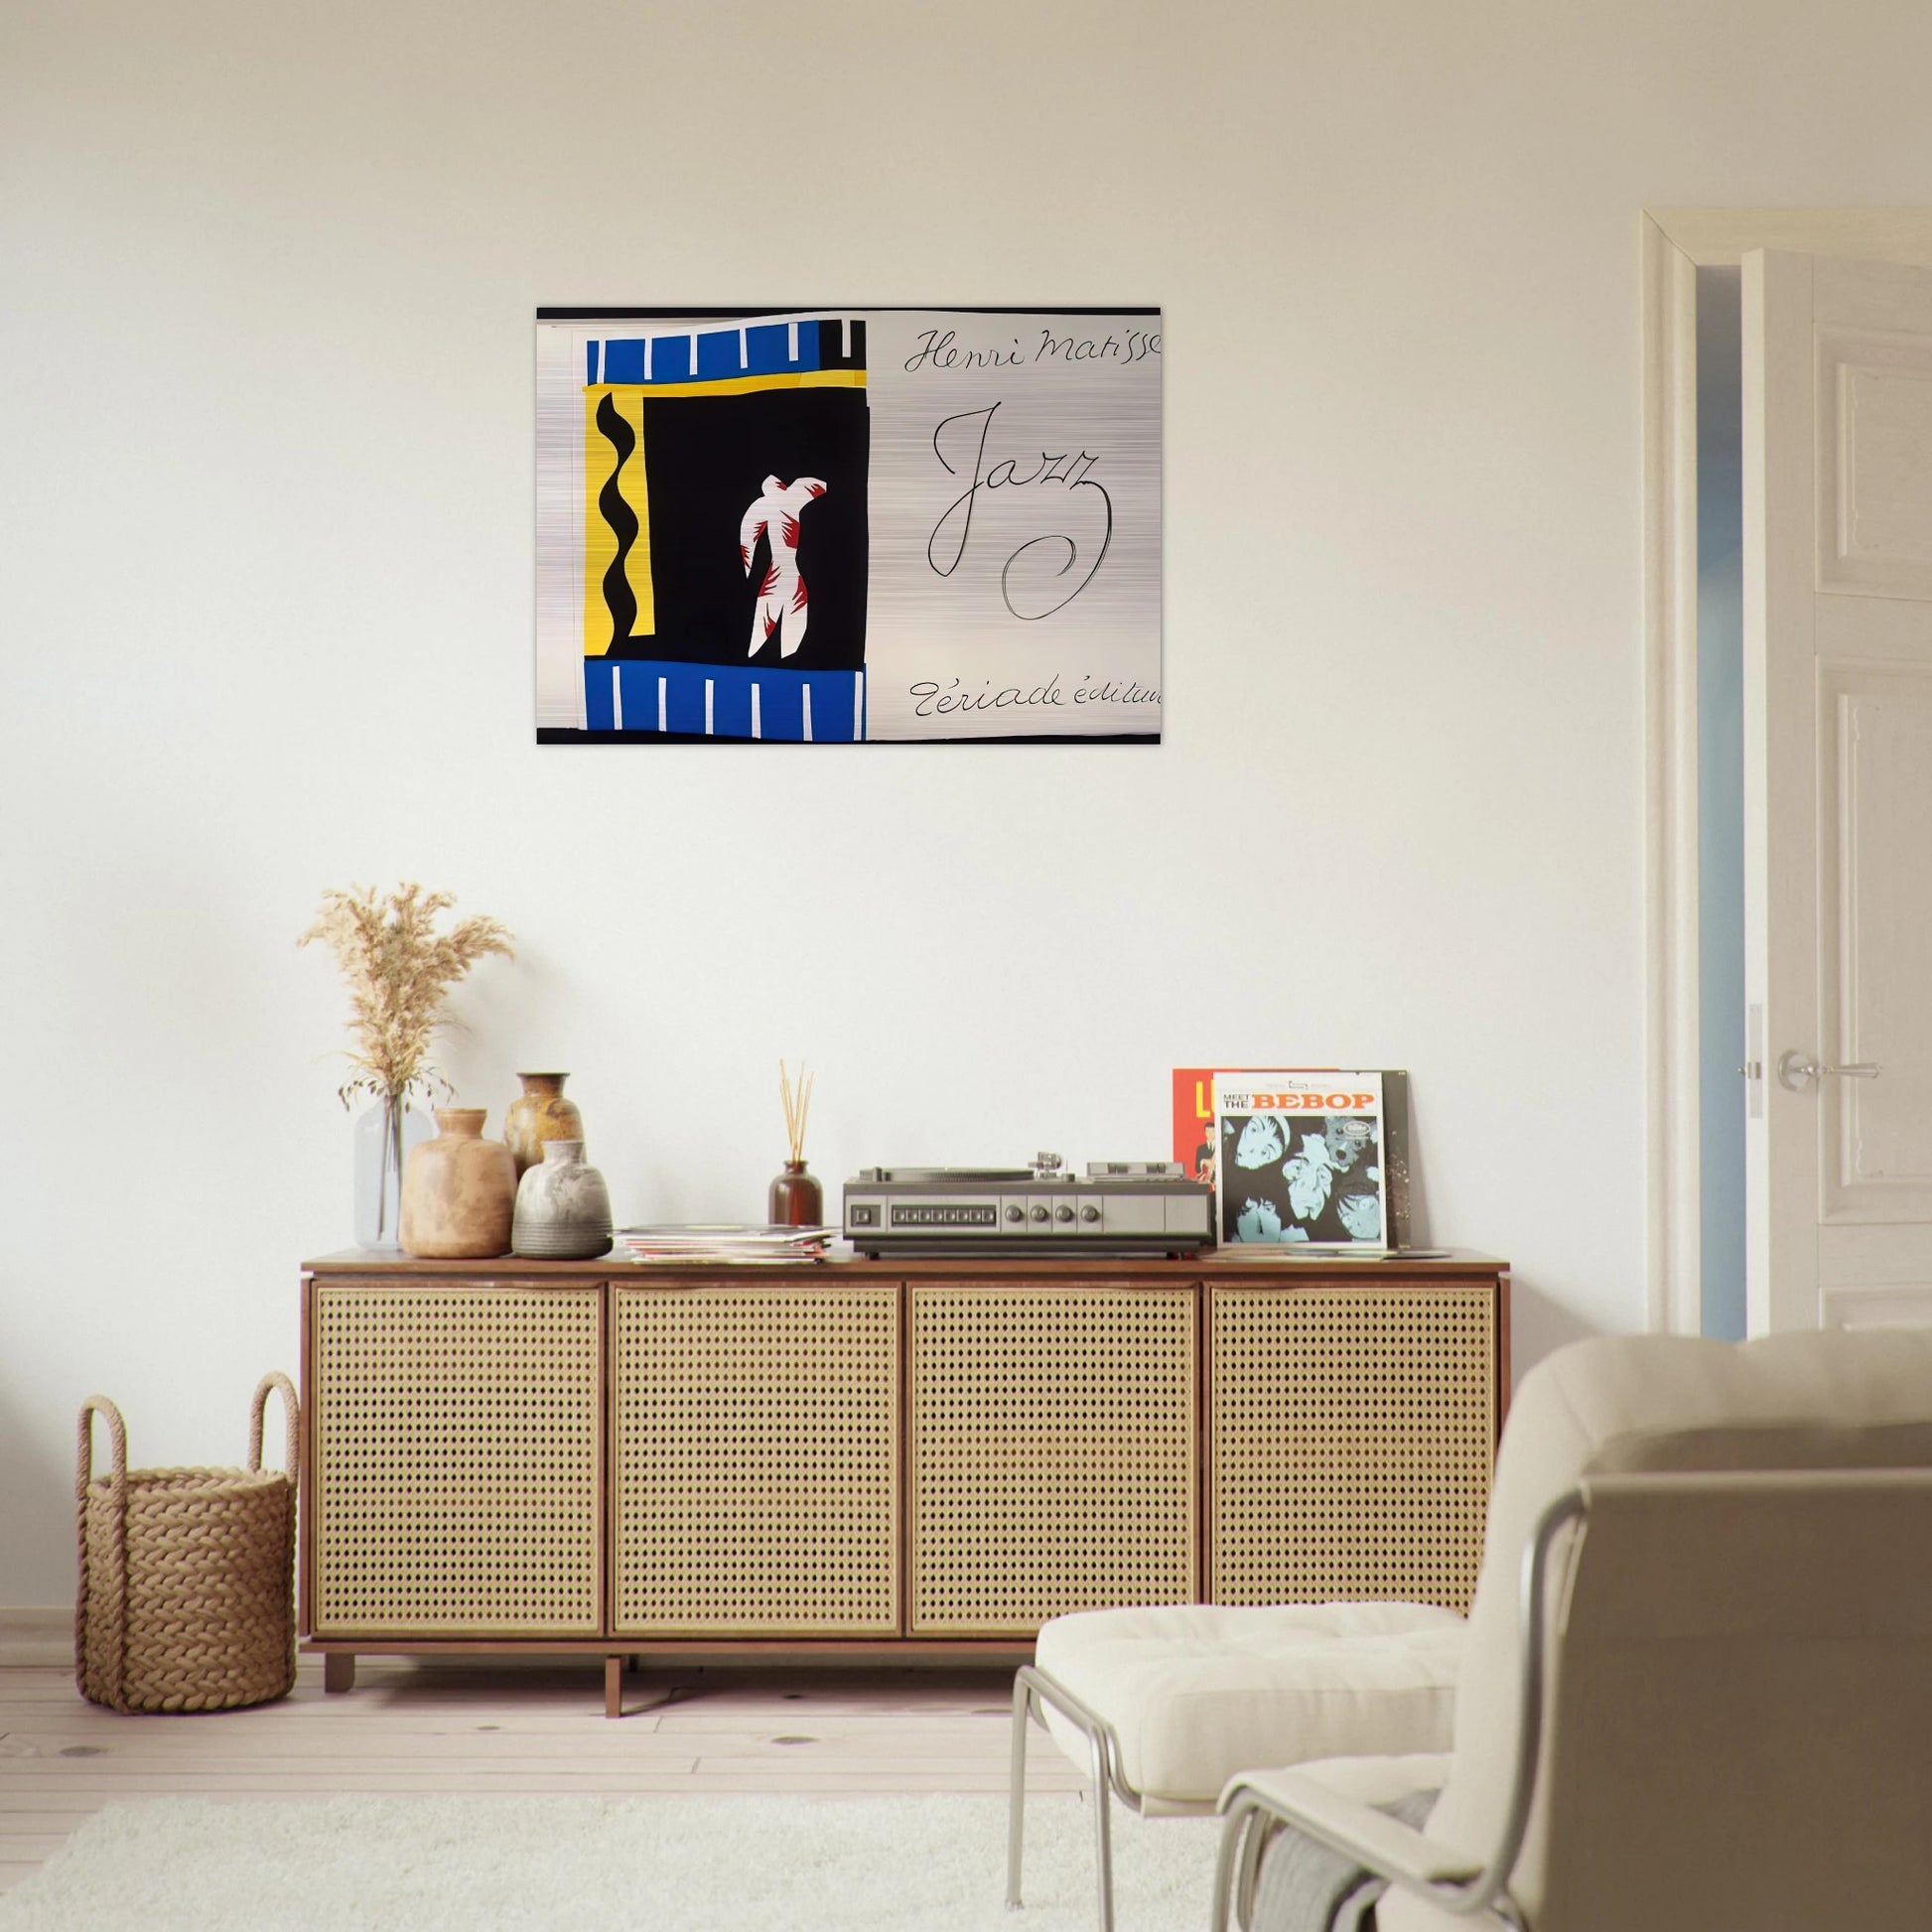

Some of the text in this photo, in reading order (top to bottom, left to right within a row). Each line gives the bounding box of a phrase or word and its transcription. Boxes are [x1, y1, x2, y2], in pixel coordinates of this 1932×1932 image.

[904, 330, 1162, 372] Henri Matisse
[928, 401, 1113, 621] Jazz
[1252, 1094, 1375, 1109] BEBOP
